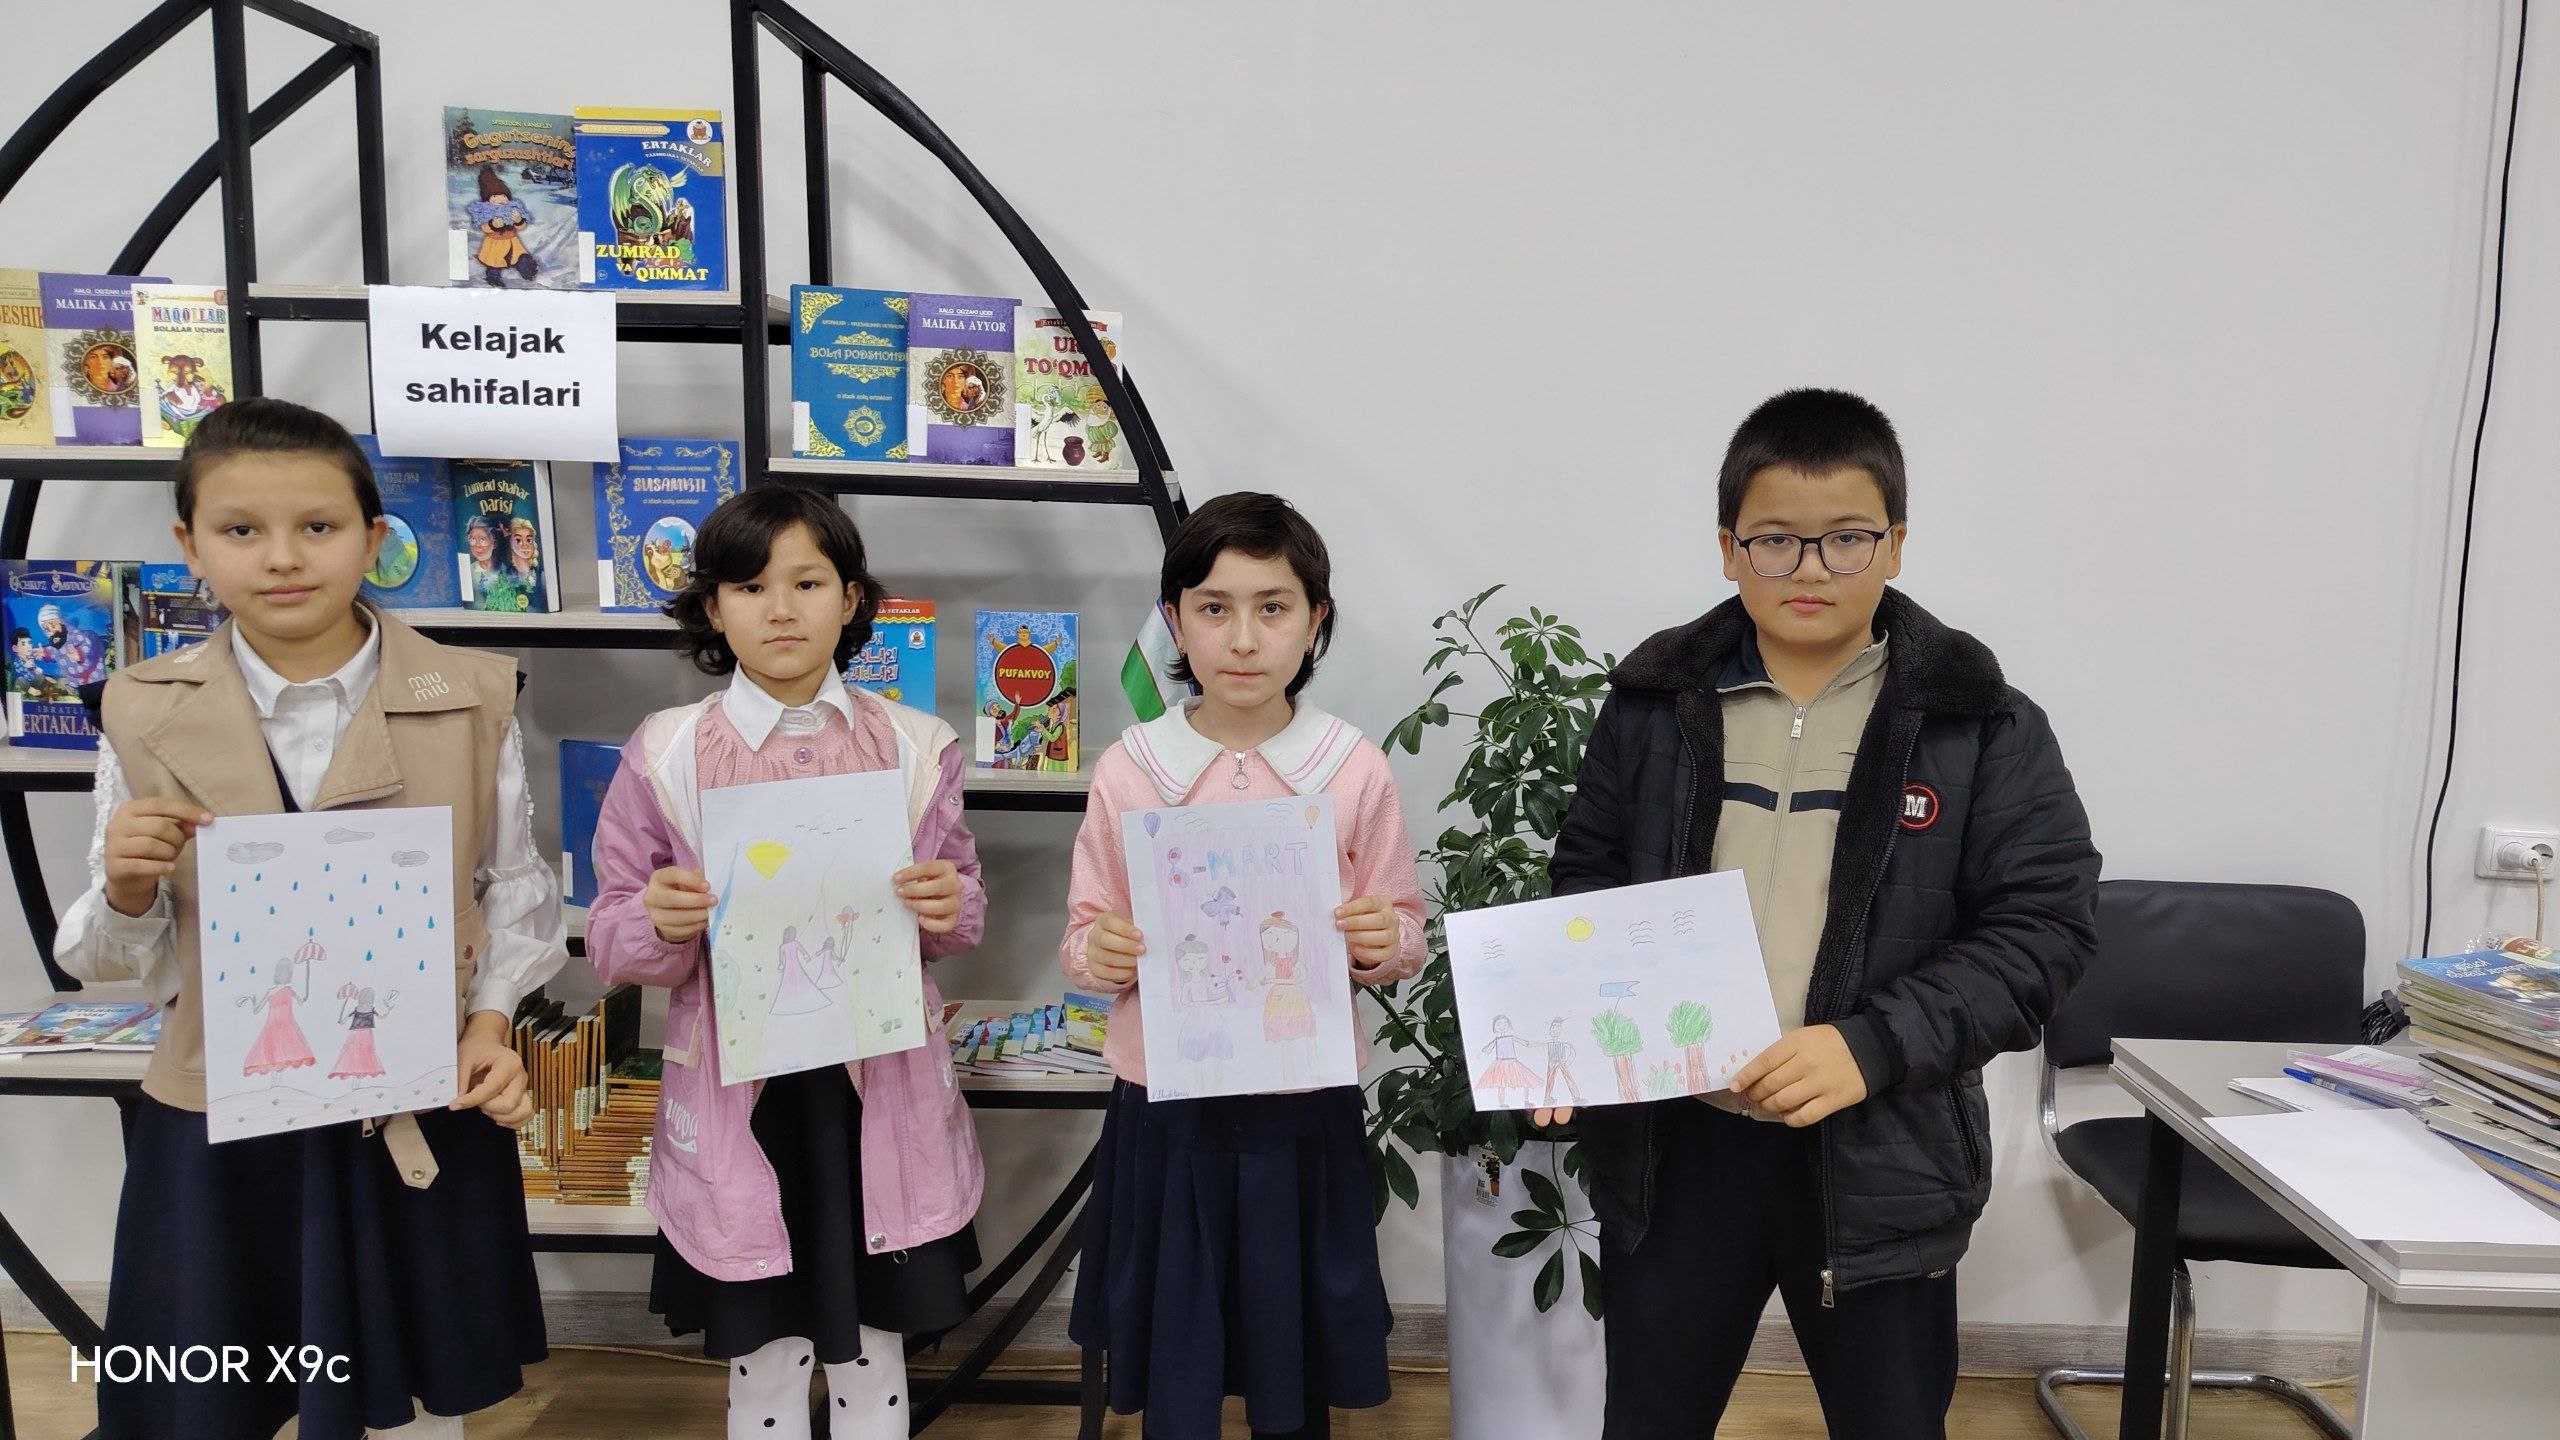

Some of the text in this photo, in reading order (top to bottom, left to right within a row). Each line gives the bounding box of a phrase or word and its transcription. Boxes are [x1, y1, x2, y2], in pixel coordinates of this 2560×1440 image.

[642, 140, 712, 167] ERTAKLAR
[596, 244, 681, 259] ZUMRAD
[616, 263, 632, 272] VA
[636, 268, 709, 282] QIMMAT
[56, 298, 133, 311] MALIKA AYY
[0, 304, 42, 329] ESHI
[151, 307, 226, 324] MAQOLLAR
[922, 318, 1006, 332] MALIKA AYYOR
[421, 323, 565, 359] Kelajak
[809, 347, 842, 358] BOLA
[1024, 357, 1117, 380] TO‘QM
[406, 377, 580, 407] sahifalari
[463, 478, 530, 500] Zumrad shahar
[479, 496, 514, 516] parisi
[999, 667, 1052, 679] PUFAKVOY
[1904, 794, 1927, 817] M
